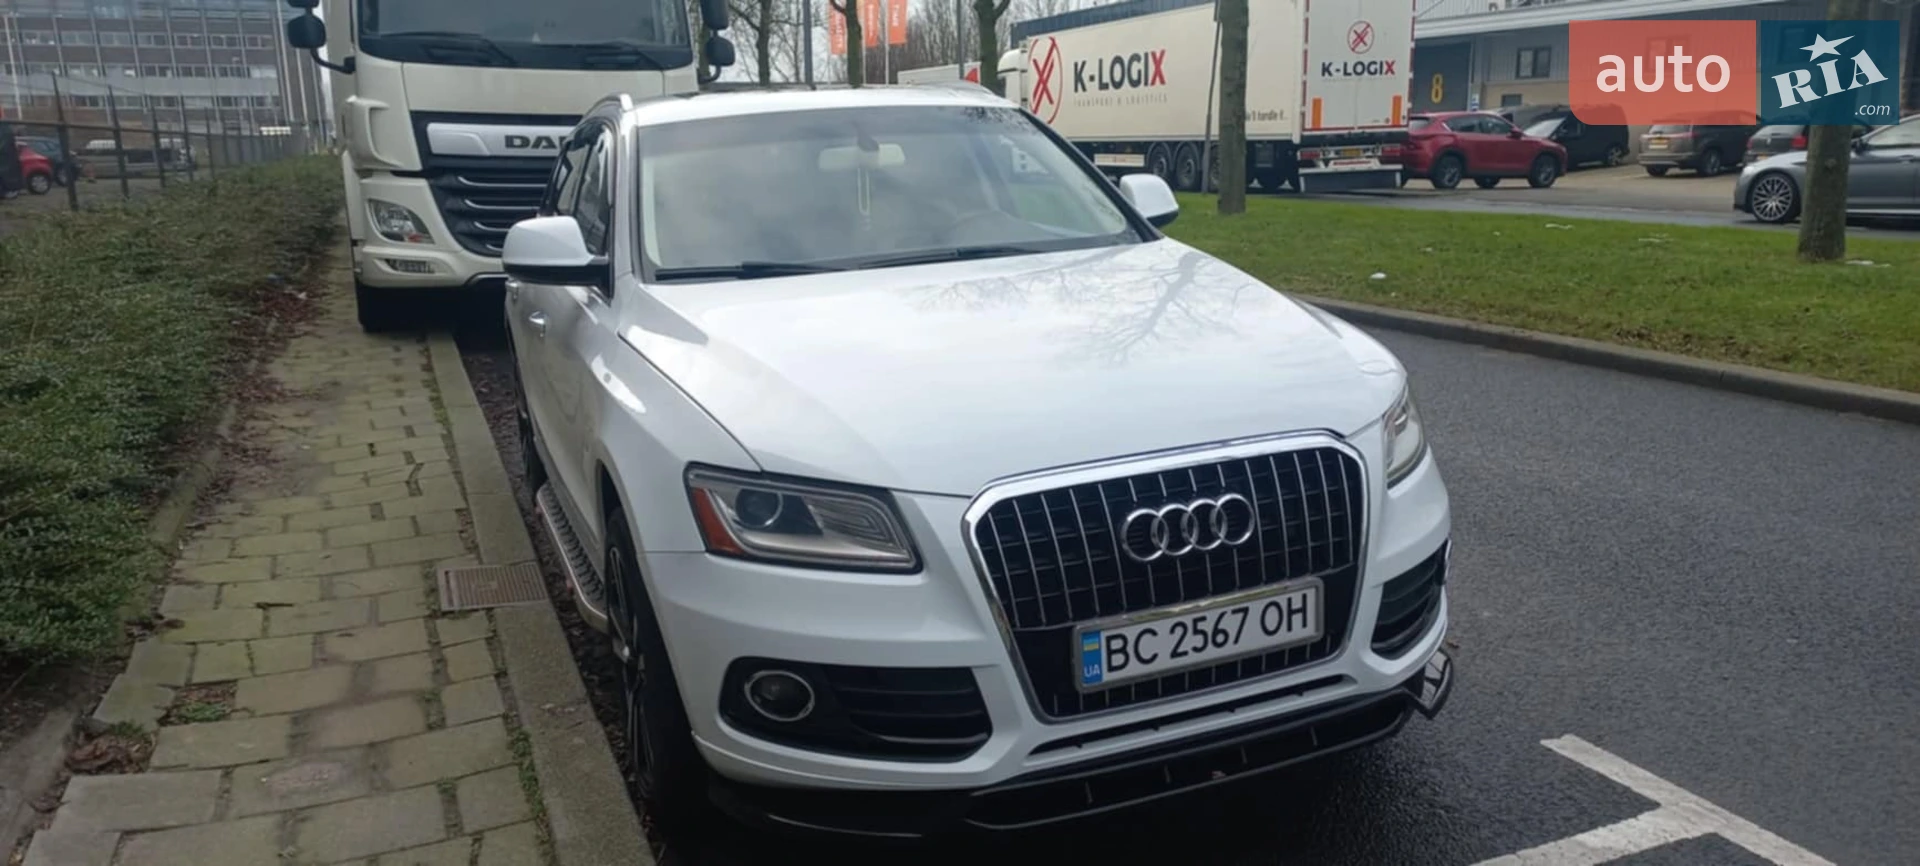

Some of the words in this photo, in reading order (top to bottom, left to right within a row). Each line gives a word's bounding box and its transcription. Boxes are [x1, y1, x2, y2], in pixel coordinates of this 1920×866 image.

[1431, 73, 1443, 104] 8
[1105, 628, 1159, 673] BC
[1169, 606, 1250, 659] 2567
[1260, 593, 1308, 636] OH
[1083, 664, 1101, 678] UA
